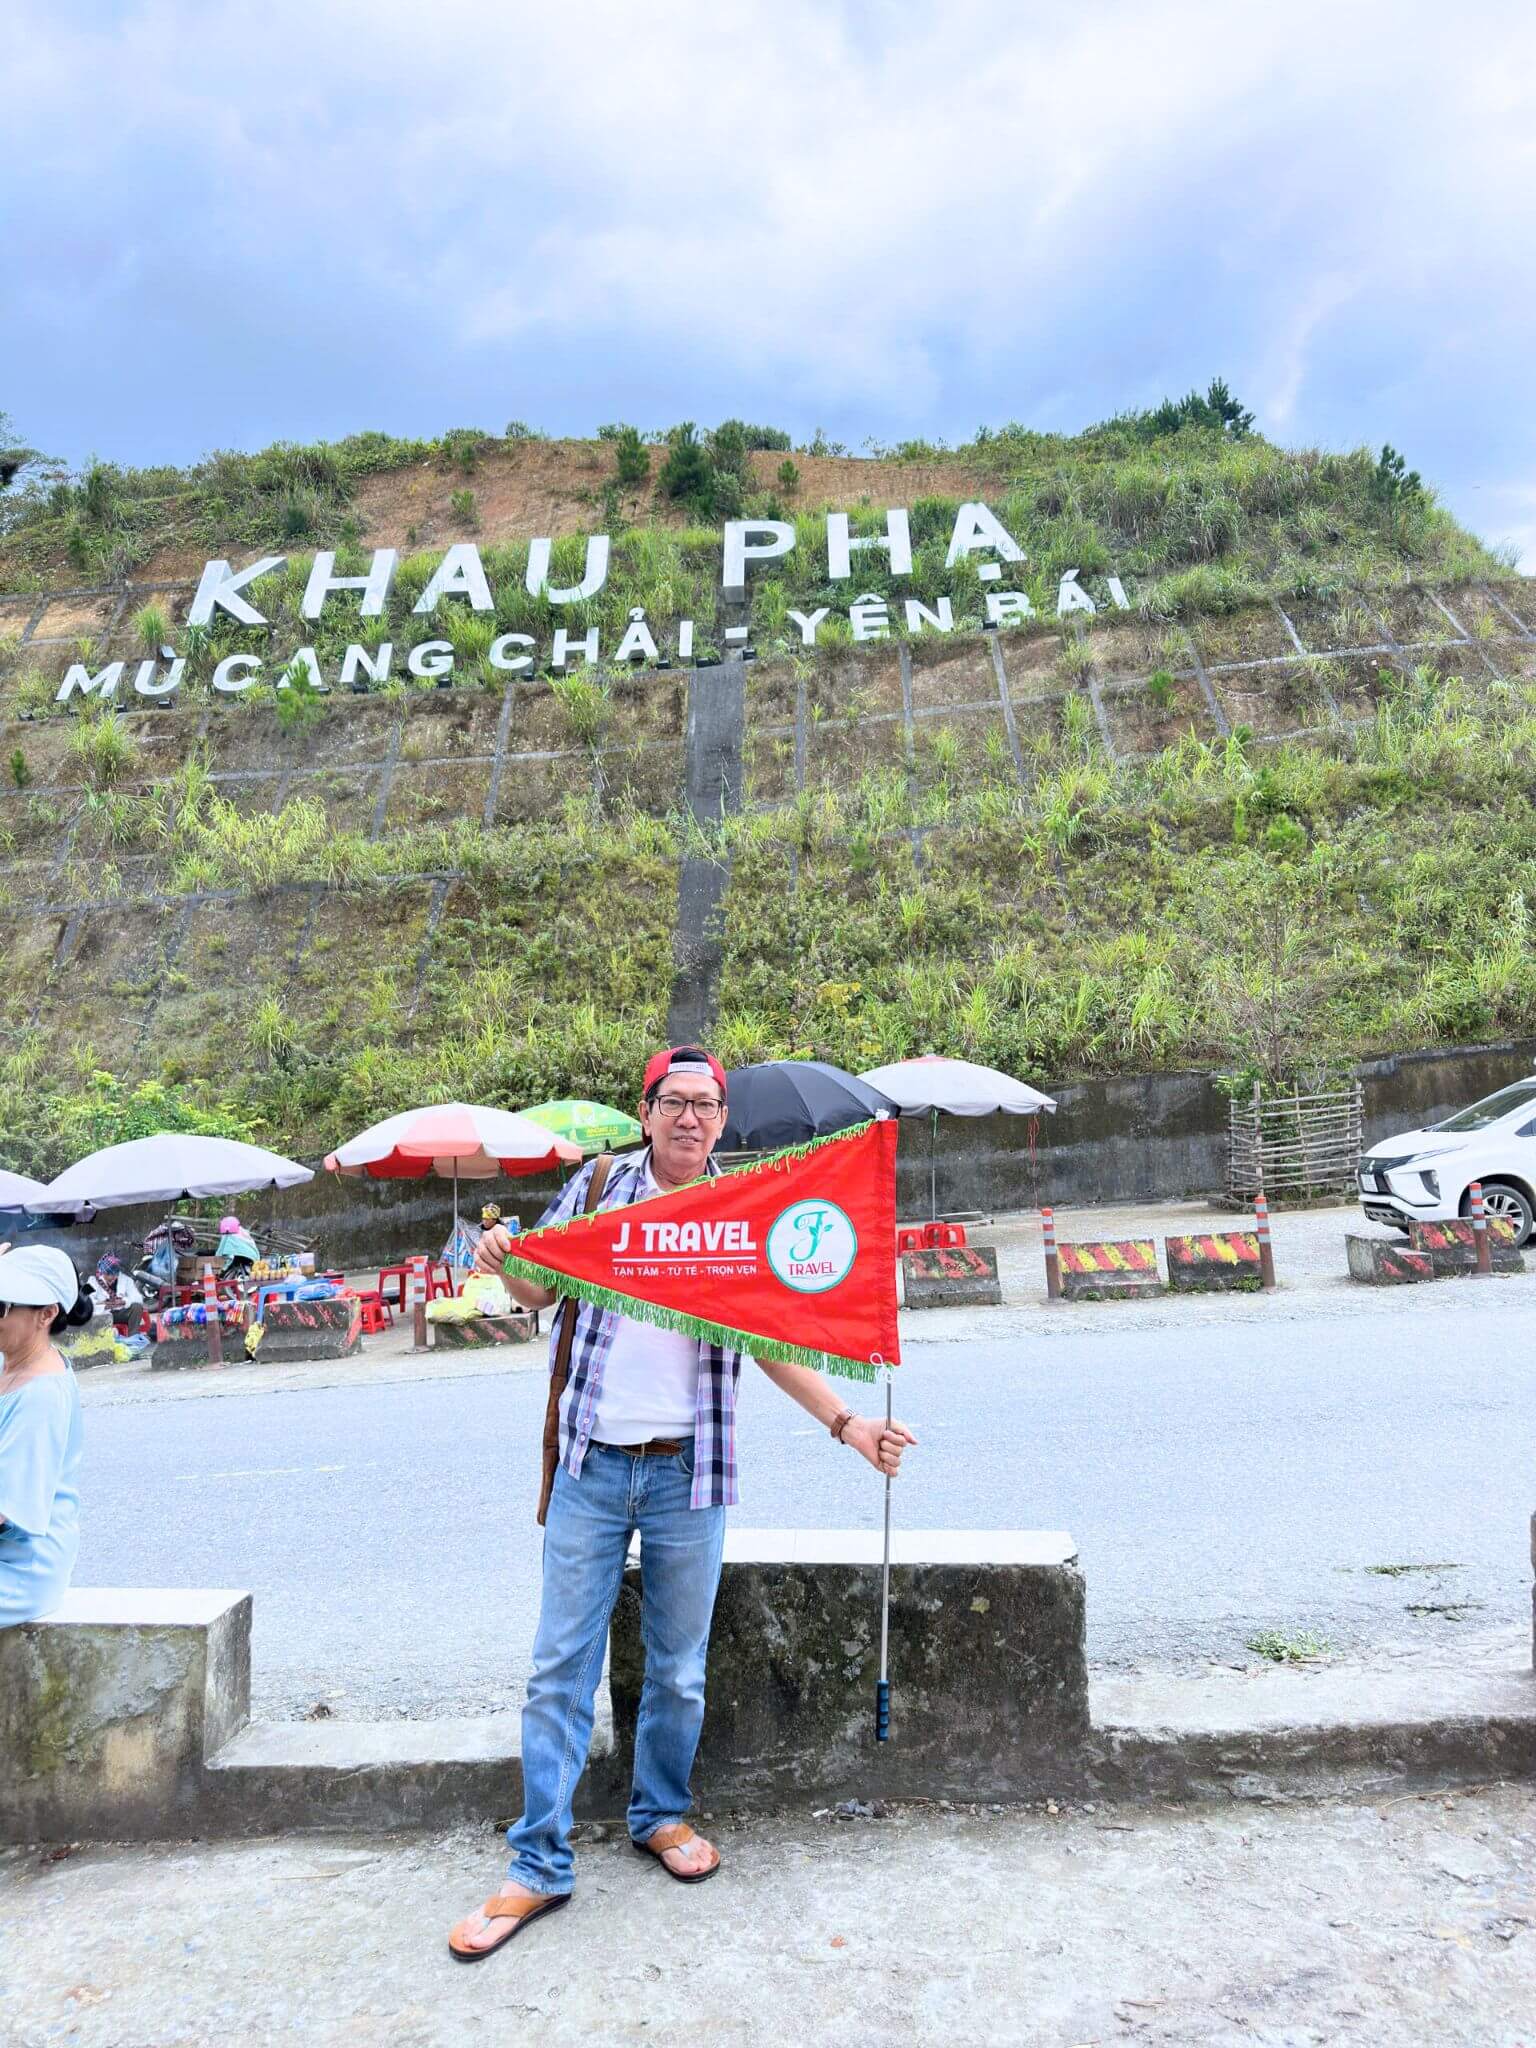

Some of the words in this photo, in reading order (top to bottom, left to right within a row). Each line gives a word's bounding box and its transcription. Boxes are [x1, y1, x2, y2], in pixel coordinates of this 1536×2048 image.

[186, 535, 611, 627] KHAU
[722, 502, 1028, 588] PHẠ
[55, 645, 187, 701] MÙ
[212, 640, 455, 692] CANG
[489, 607, 694, 670] CHẢI
[786, 593, 954, 646] YÊN
[985, 569, 1131, 627] BÁI
[612, 1222, 631, 1252] J
[641, 1221, 757, 1252] TRAVEL
[787, 1261, 838, 1276] TRAVEL
